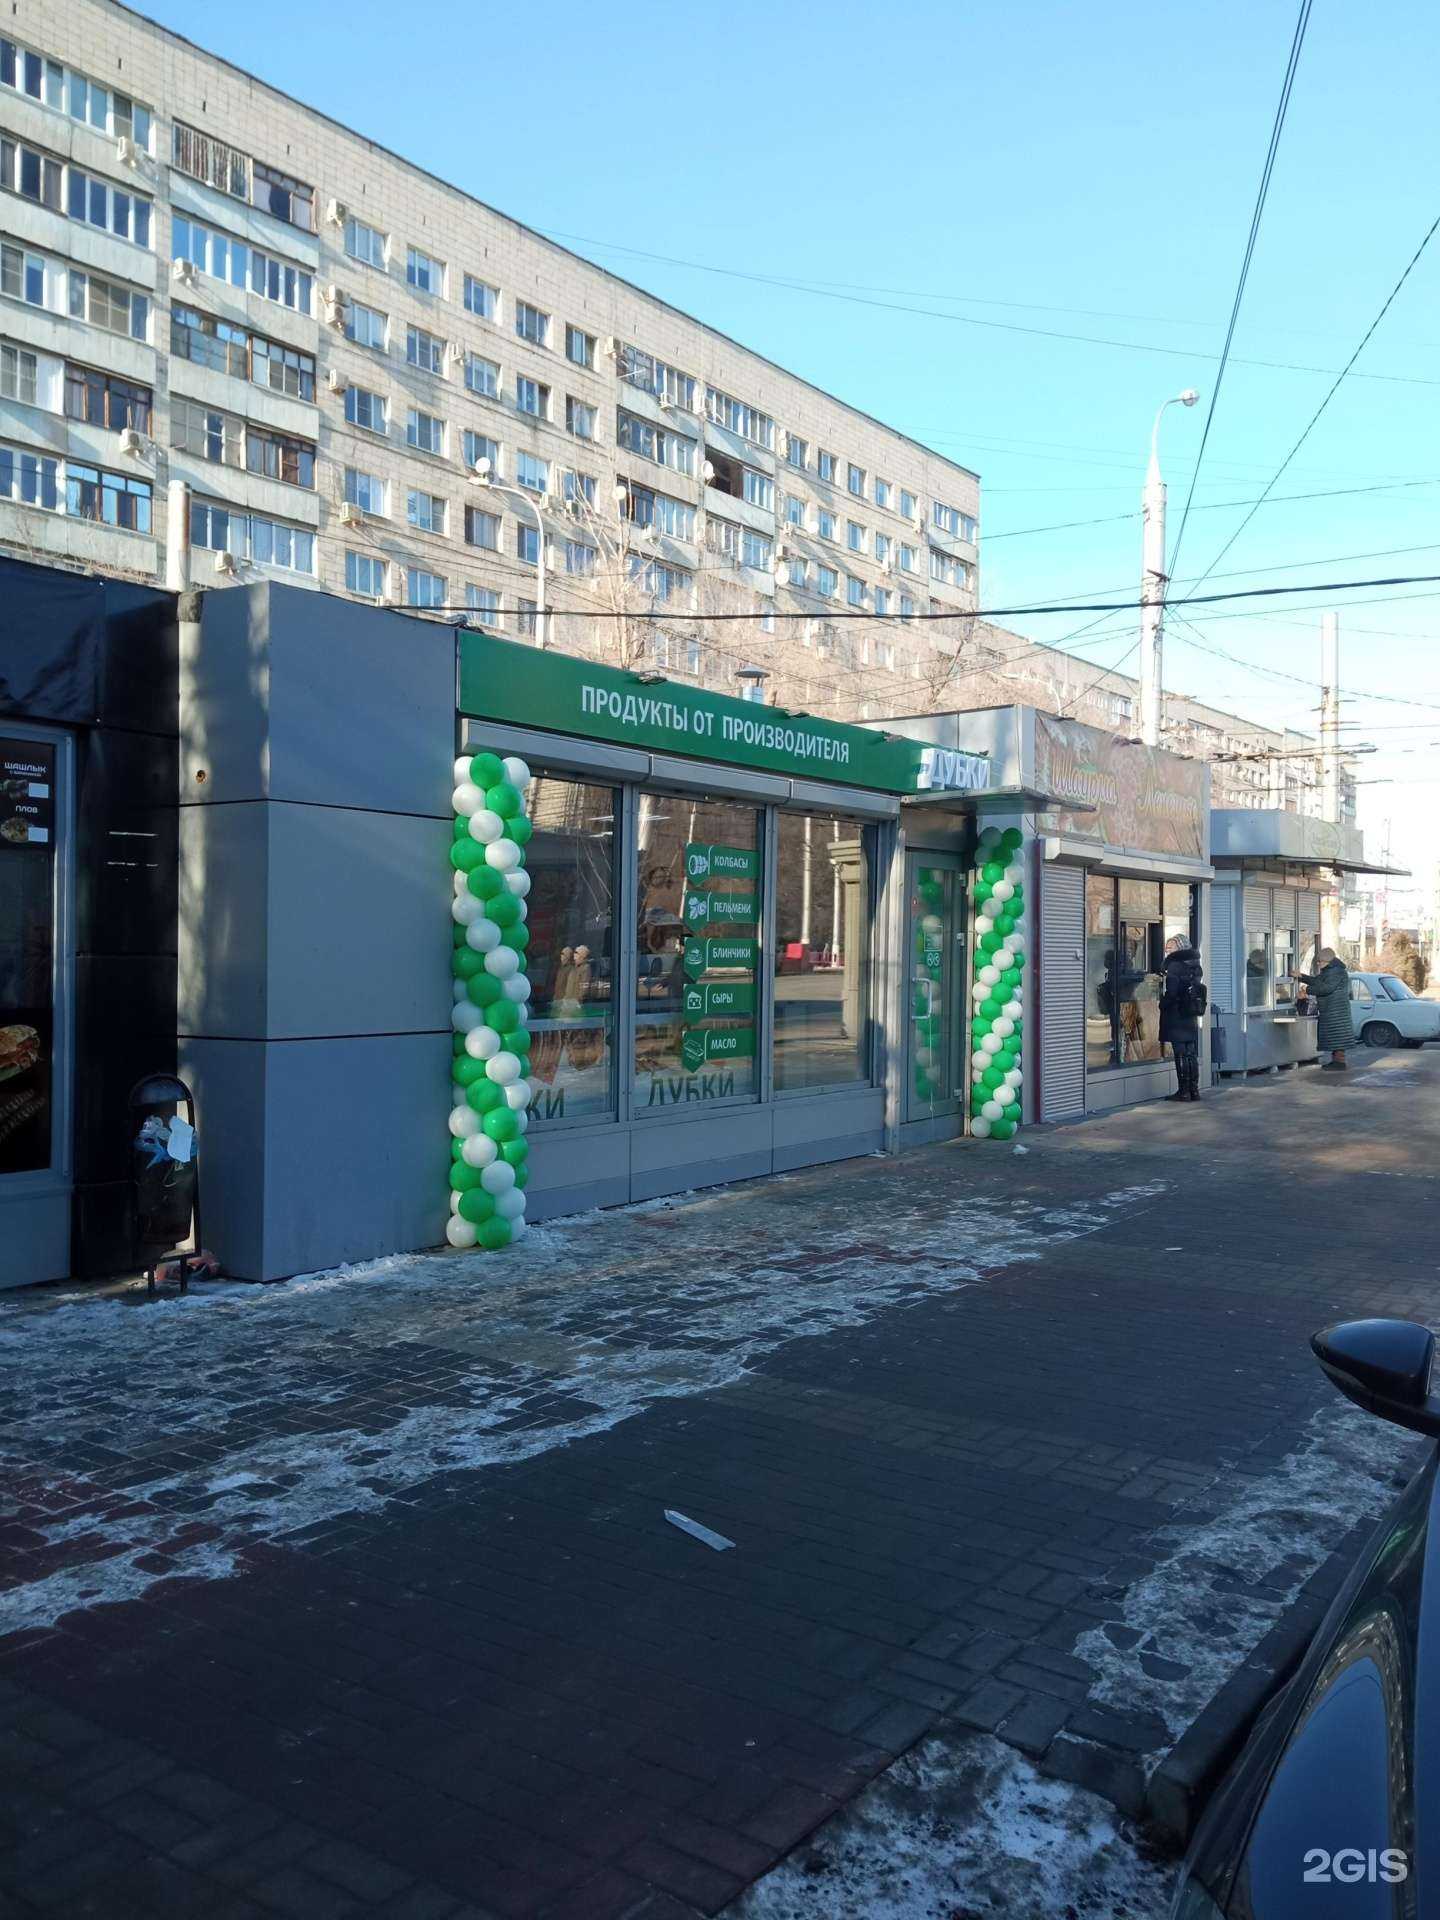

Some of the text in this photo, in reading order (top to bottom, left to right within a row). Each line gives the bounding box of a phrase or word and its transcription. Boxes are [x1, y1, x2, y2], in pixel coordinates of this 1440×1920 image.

[581, 685, 849, 764] ПРОДУКТЫ ОТ ПРОИЗВОДИТЕЛЯ
[917, 748, 991, 790] ДУБКИ
[714, 855, 749, 869] КОЛБАСЫ
[713, 901, 751, 914] ПЕЛЬМЕНИ
[712, 947, 751, 959] БЛИНЧИКИ
[711, 992, 733, 1004] СЫРЫ
[711, 1038, 737, 1049] МАСЛО
